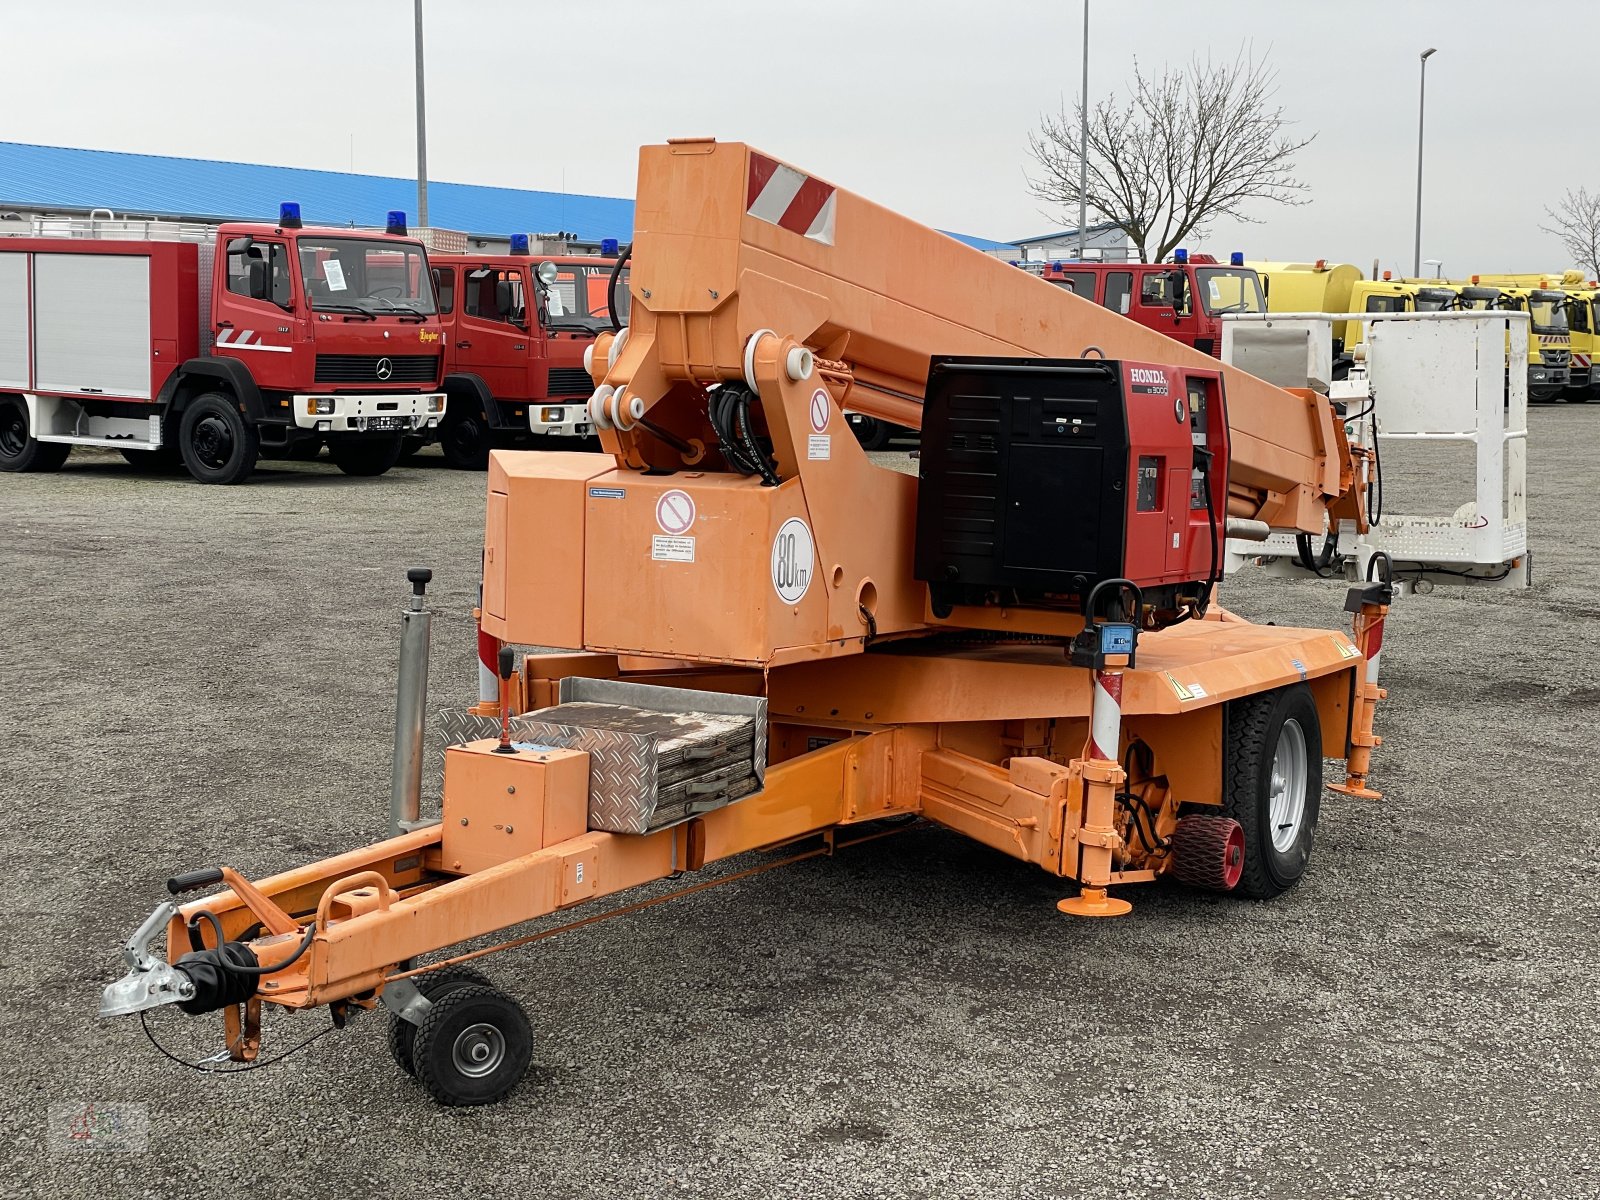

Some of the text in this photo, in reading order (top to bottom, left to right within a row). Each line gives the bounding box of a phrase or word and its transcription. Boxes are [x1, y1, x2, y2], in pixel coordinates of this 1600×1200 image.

[1130, 368, 1167, 384] HONDA
[1152, 386, 1169, 396] 3000
[778, 533, 807, 588] 80 km
